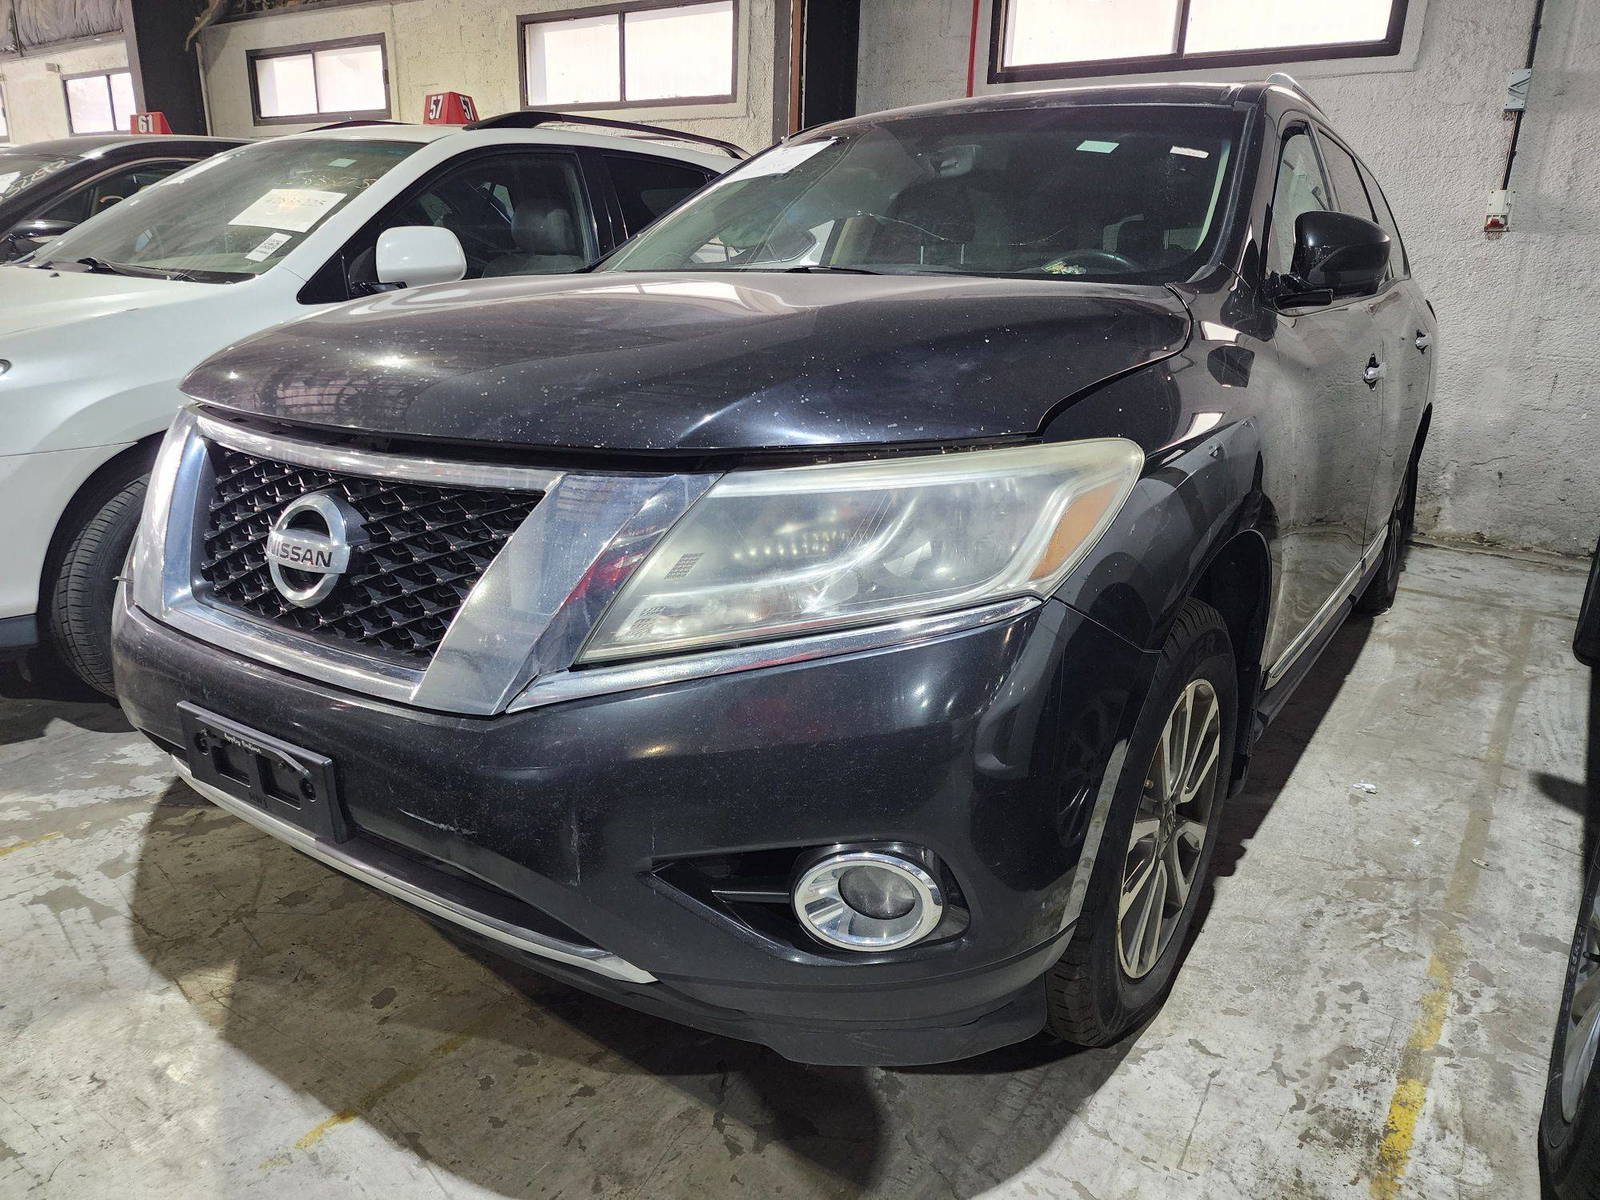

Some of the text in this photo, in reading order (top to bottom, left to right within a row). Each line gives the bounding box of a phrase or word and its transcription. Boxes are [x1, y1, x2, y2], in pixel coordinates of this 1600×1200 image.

[429, 95, 443, 120] 57
[458, 95, 475, 121] 57
[137, 114, 154, 133] 61
[268, 540, 333, 567] NISSAN
